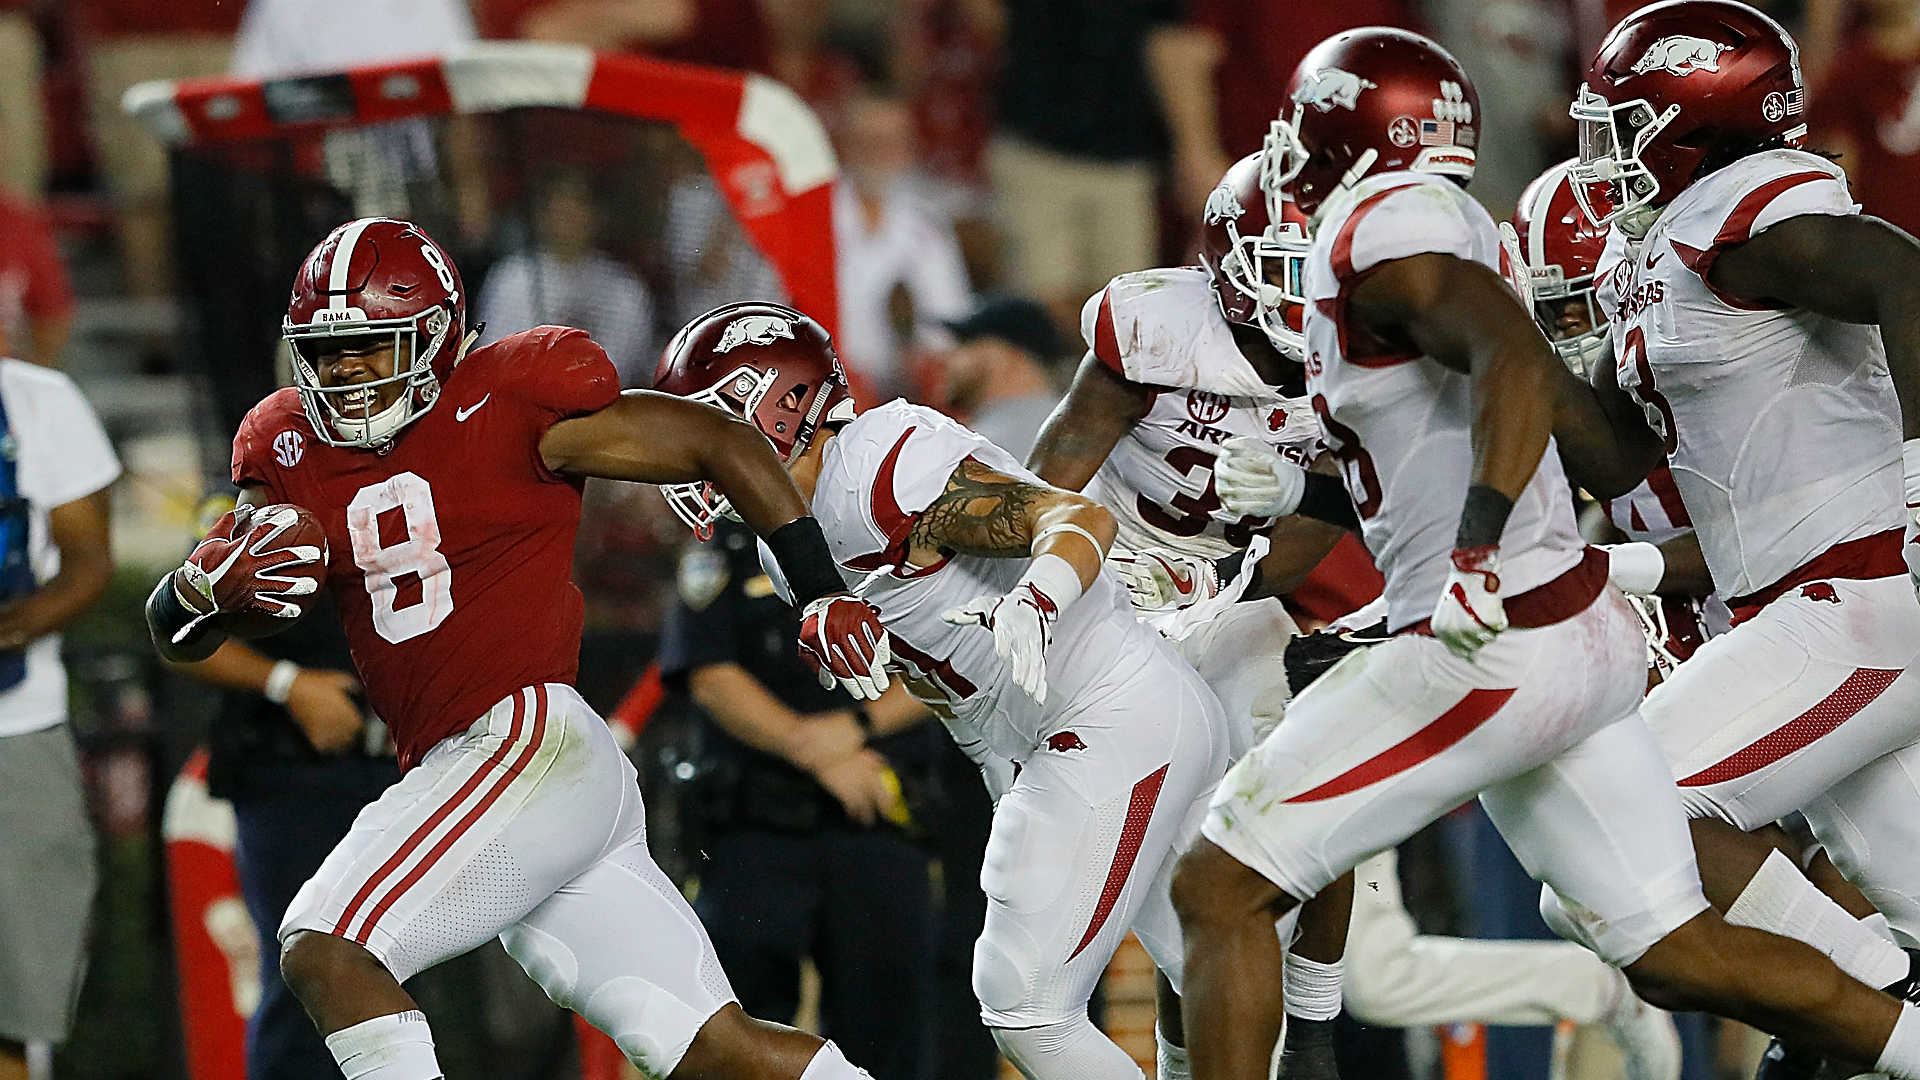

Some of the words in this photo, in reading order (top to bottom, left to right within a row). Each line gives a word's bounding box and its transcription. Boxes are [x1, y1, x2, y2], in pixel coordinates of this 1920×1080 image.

[420, 244, 455, 293] 8
[322, 311, 352, 322] BAMA
[272, 430, 305, 468] SEC
[346, 470, 455, 645] 8
